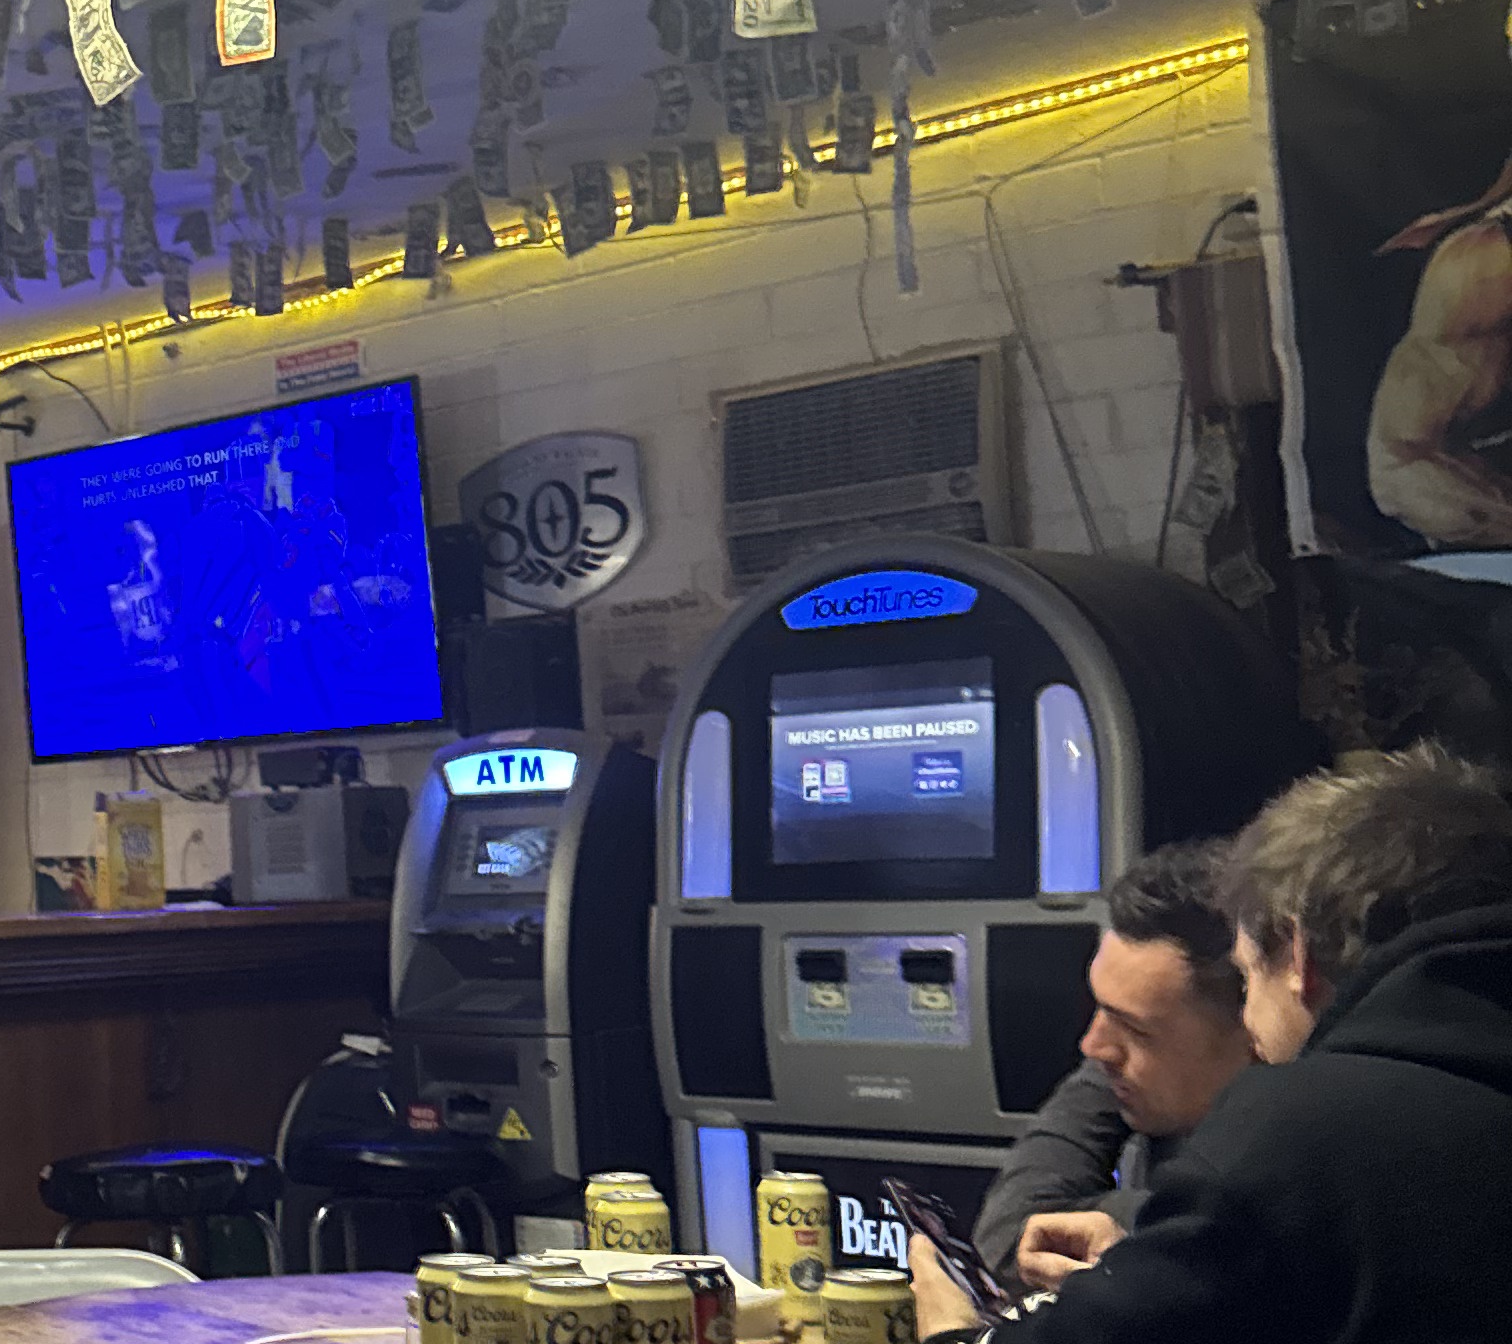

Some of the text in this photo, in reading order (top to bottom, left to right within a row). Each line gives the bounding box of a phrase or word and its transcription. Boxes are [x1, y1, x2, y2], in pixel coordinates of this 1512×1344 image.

[80, 475, 107, 489] THEY
[112, 469, 141, 483] WERE
[145, 459, 183, 478] GOING
[185, 455, 202, 468] TO
[204, 449, 230, 466] RUN
[228, 441, 269, 459] THERE
[188, 471, 219, 488] THAT
[481, 466, 630, 568] 805
[808, 586, 945, 620] TouchTunes
[787, 719, 980, 745] MUSIC HAS BEEN PAUSED
[476, 754, 545, 785] ATM
[838, 1196, 909, 1269] BEAT
